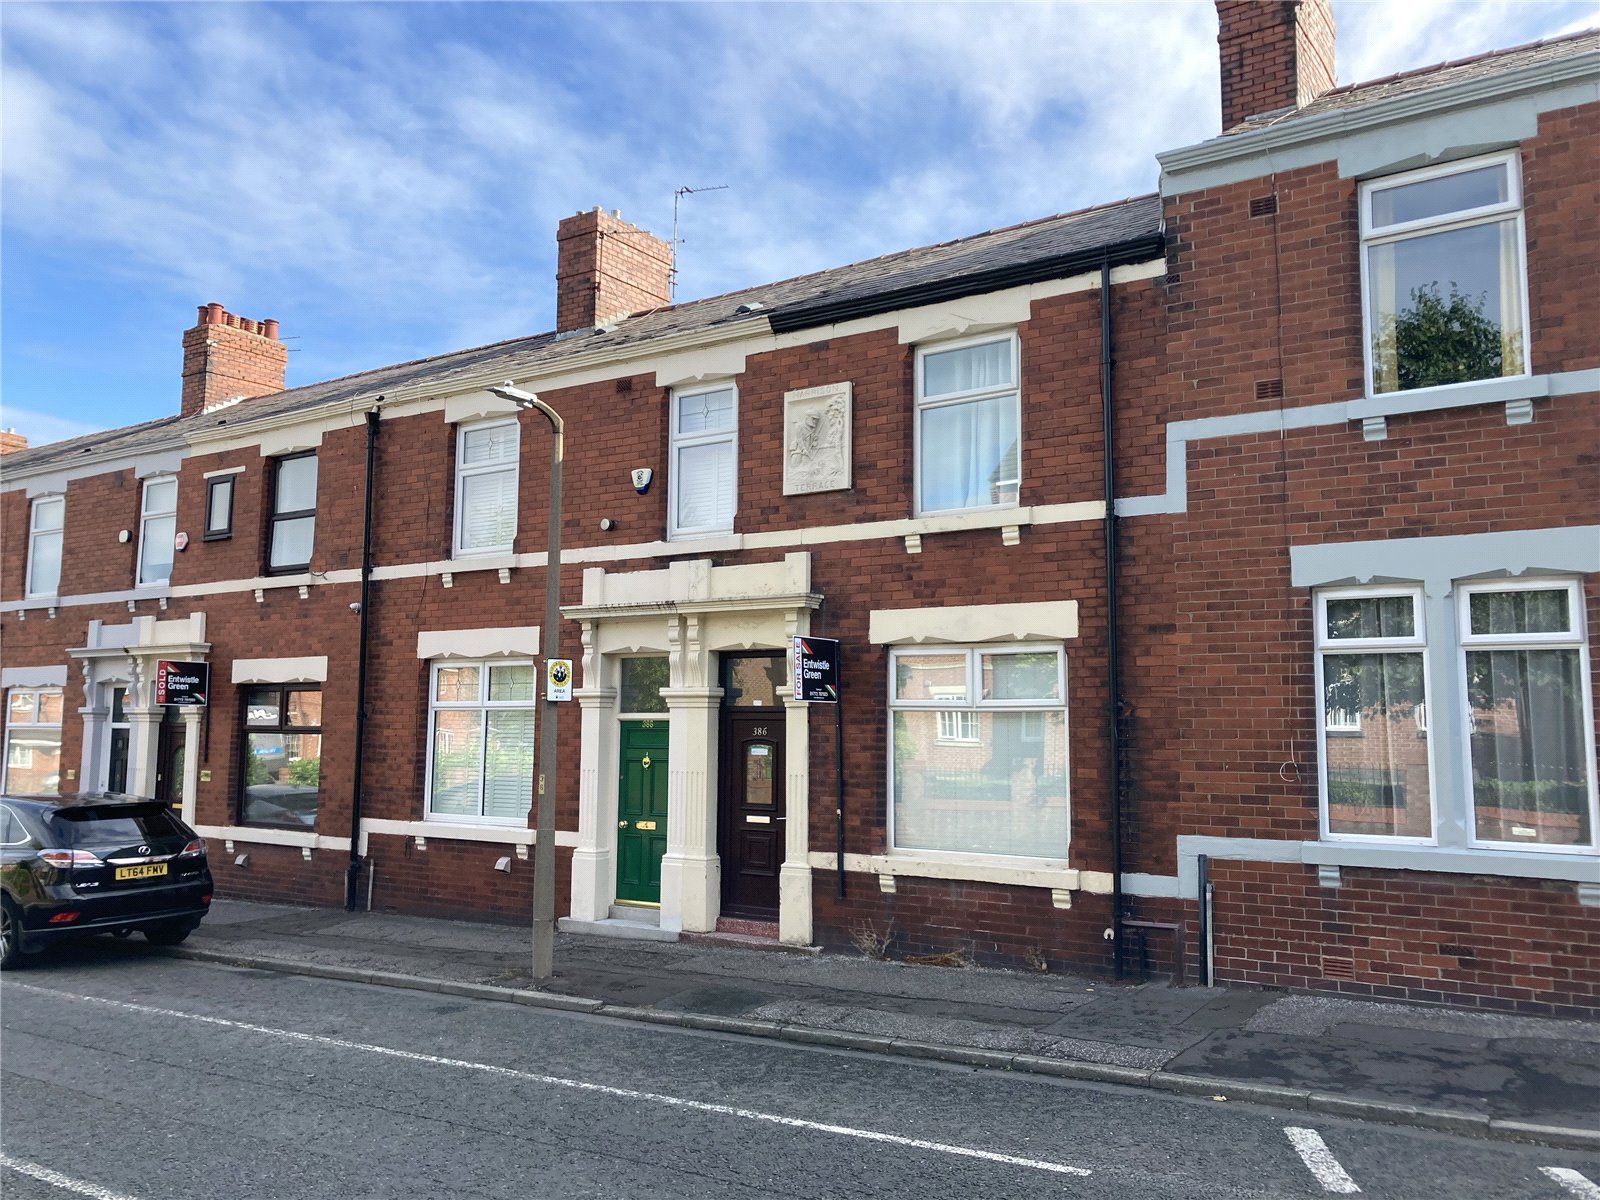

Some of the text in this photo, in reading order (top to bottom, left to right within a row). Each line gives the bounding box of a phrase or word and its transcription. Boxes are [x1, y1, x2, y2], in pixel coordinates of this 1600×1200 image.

[795, 480, 836, 492] TERRACE
[803, 659, 830, 670] Entwistle
[168, 675, 199, 684] Entwistle
[803, 669, 822, 680] Green
[158, 669, 166, 695] SOLD
[752, 727, 768, 736] 386
[120, 865, 165, 878] LT64 FMV
